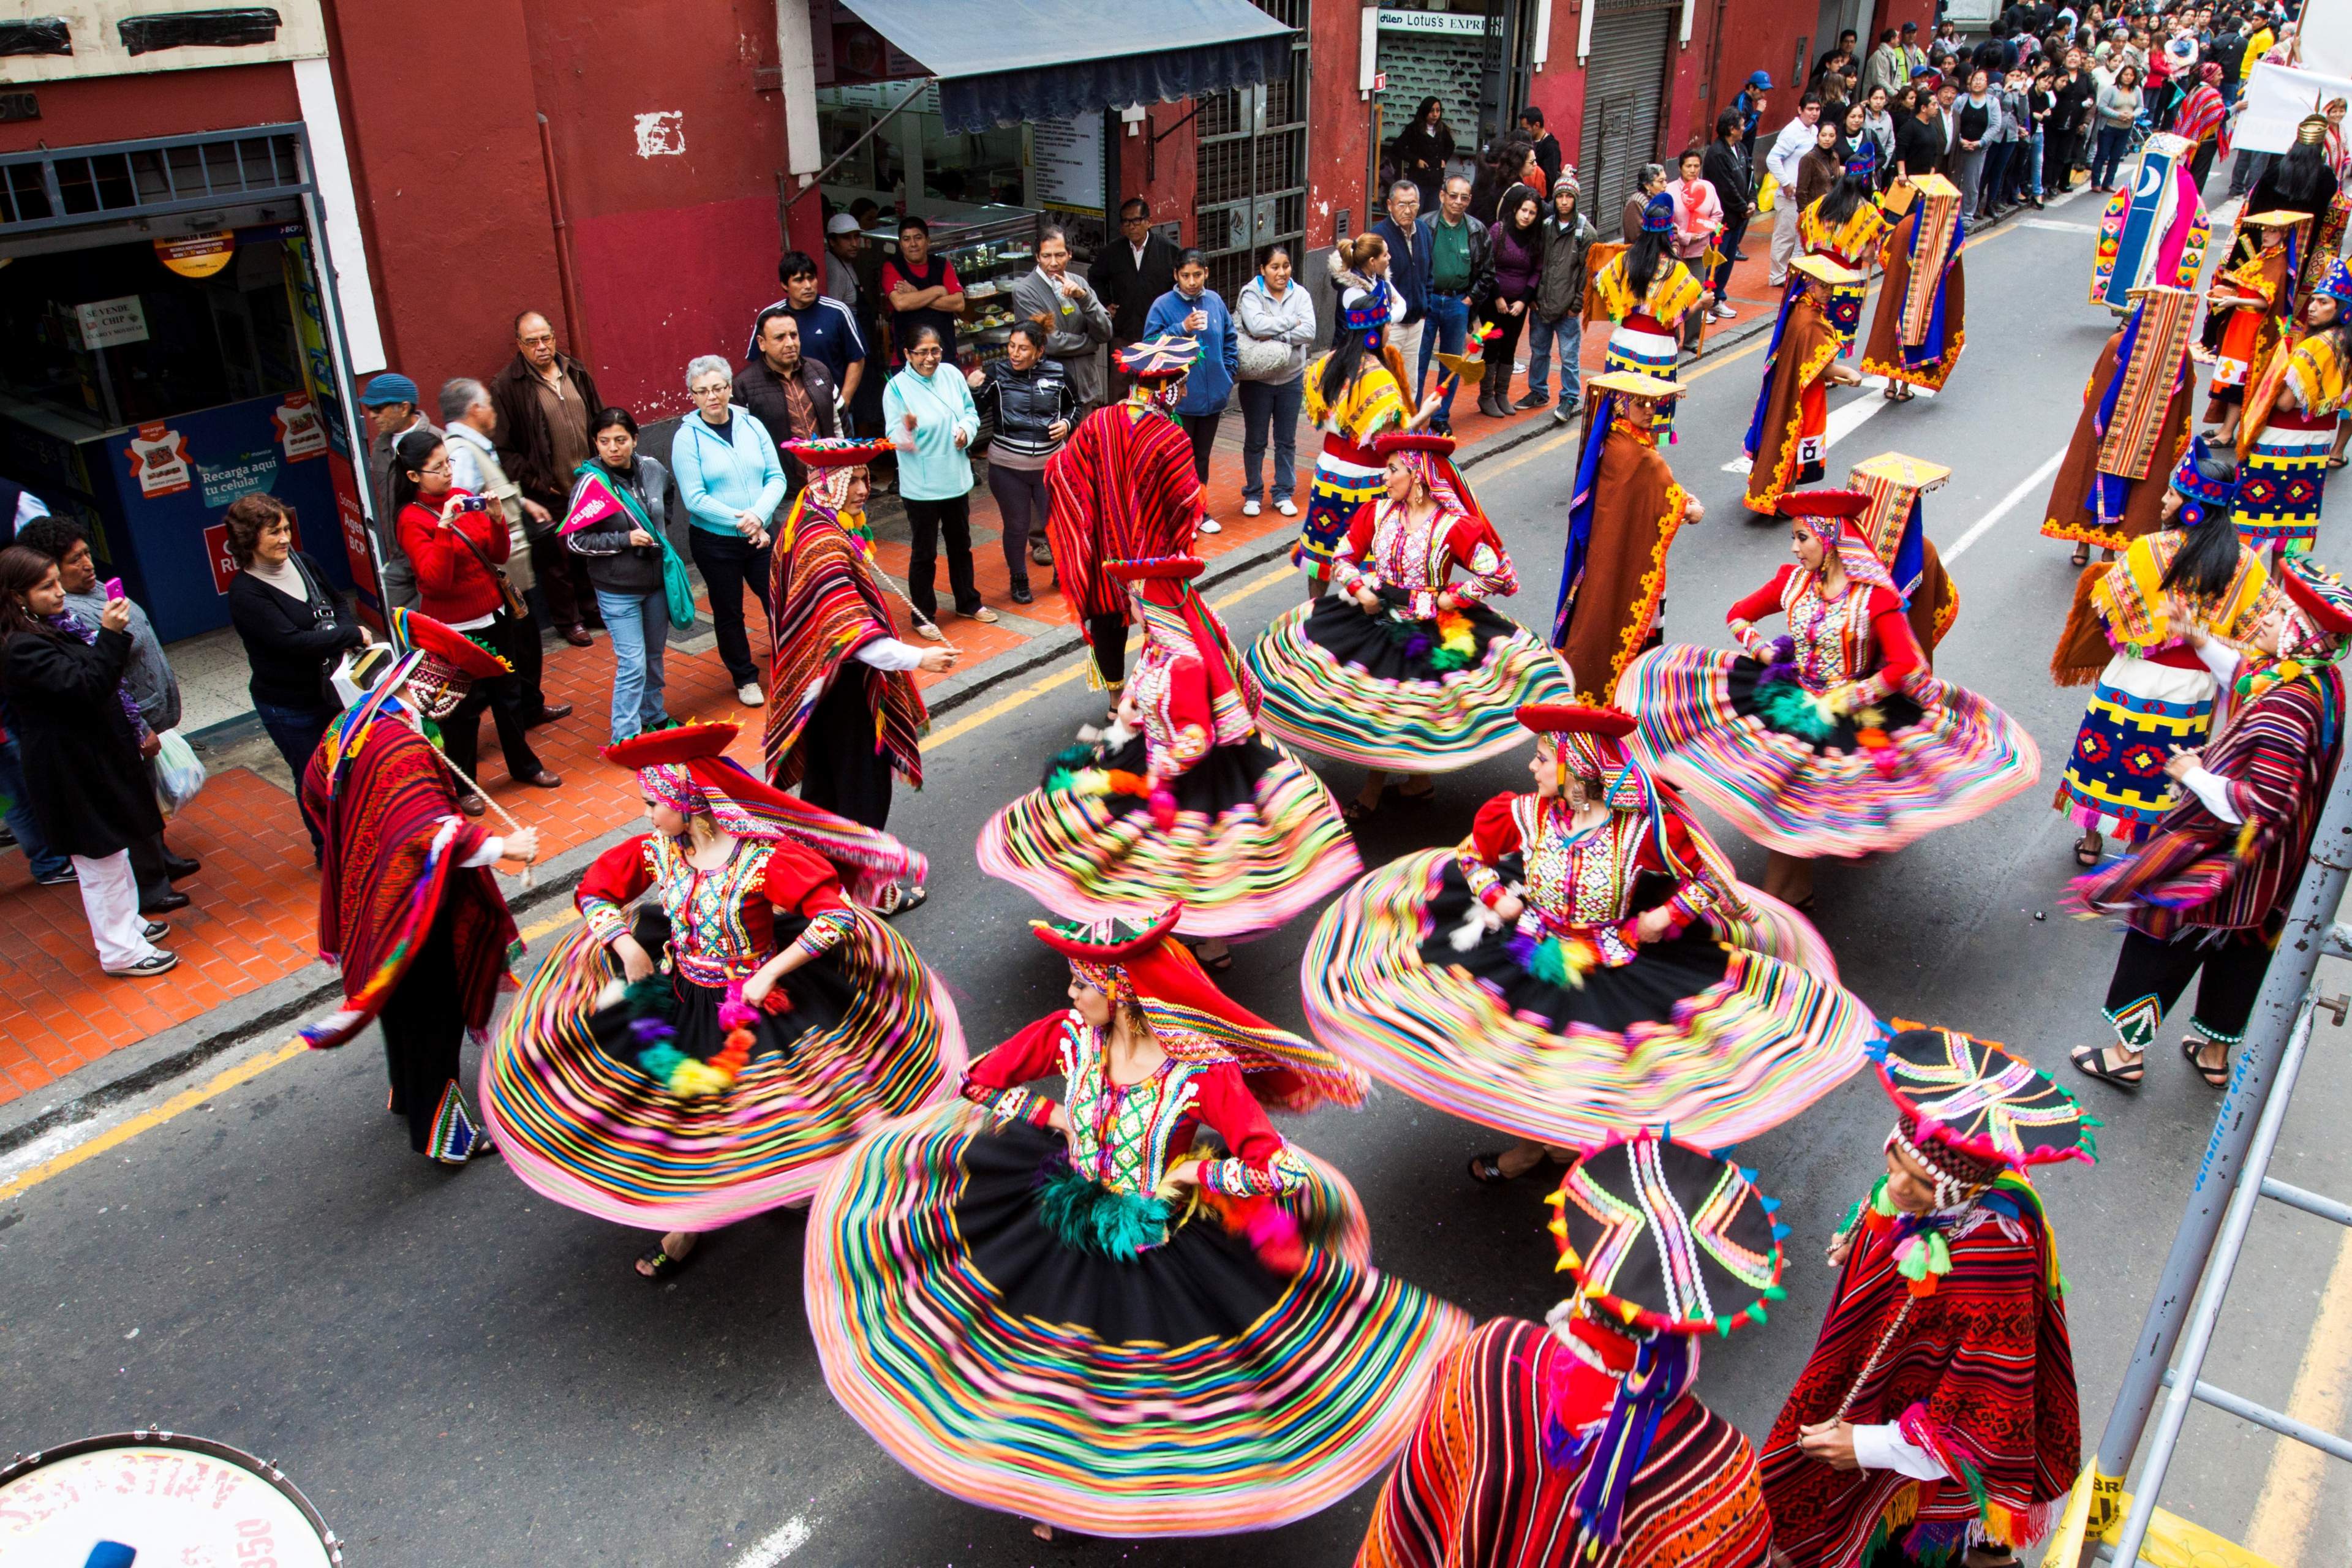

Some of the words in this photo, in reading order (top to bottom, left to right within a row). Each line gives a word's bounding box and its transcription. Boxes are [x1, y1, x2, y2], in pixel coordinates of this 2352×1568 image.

[1407, 14, 1444, 27] Lotus's
[162, 234, 196, 244] VIRTUALES
[86, 309, 97, 318] SE
[99, 304, 130, 315] VENDE
[102, 315, 124, 326] CHIP
[87, 331, 107, 340] CLARO
[113, 325, 143, 334] MOVISTAR
[202, 467, 250, 484] Recarga
[252, 456, 277, 472] aquí
[205, 486, 219, 496] tu
[221, 477, 260, 492] celular
[339, 492, 360, 514] Somos
[571, 499, 600, 525] CELEBRA
[349, 535, 365, 556] BCP
